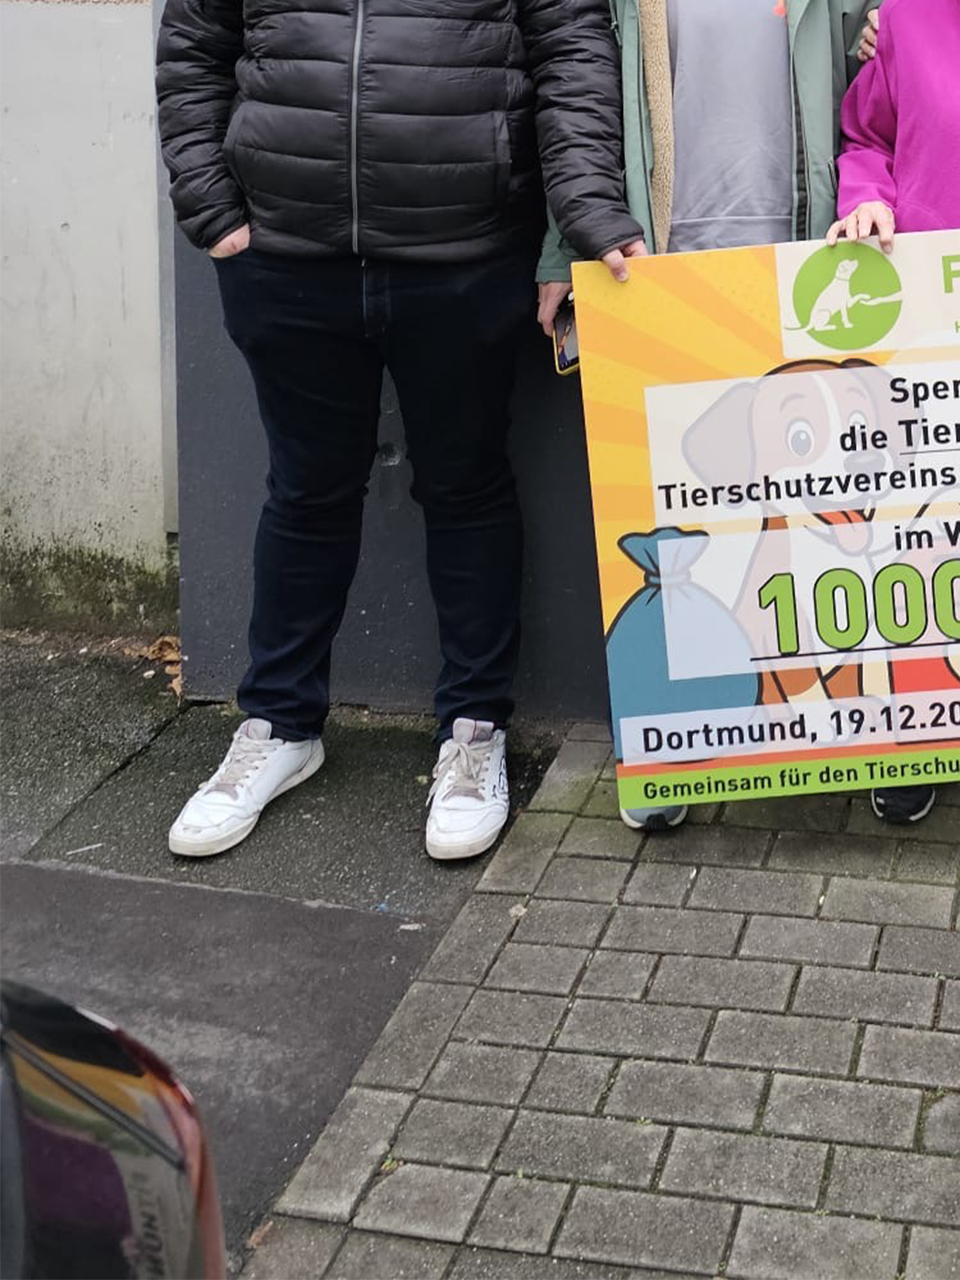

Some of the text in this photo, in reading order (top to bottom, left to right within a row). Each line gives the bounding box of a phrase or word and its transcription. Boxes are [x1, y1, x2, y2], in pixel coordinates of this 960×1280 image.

[839, 424, 888, 452] die
[657, 462, 957, 510] Tierschutzvereins
[894, 525, 933, 550] im
[642, 713, 818, 753] Dortmund,
[643, 775, 773, 800] Gemeinsam
[779, 767, 812, 788] für
[819, 764, 859, 784] den
